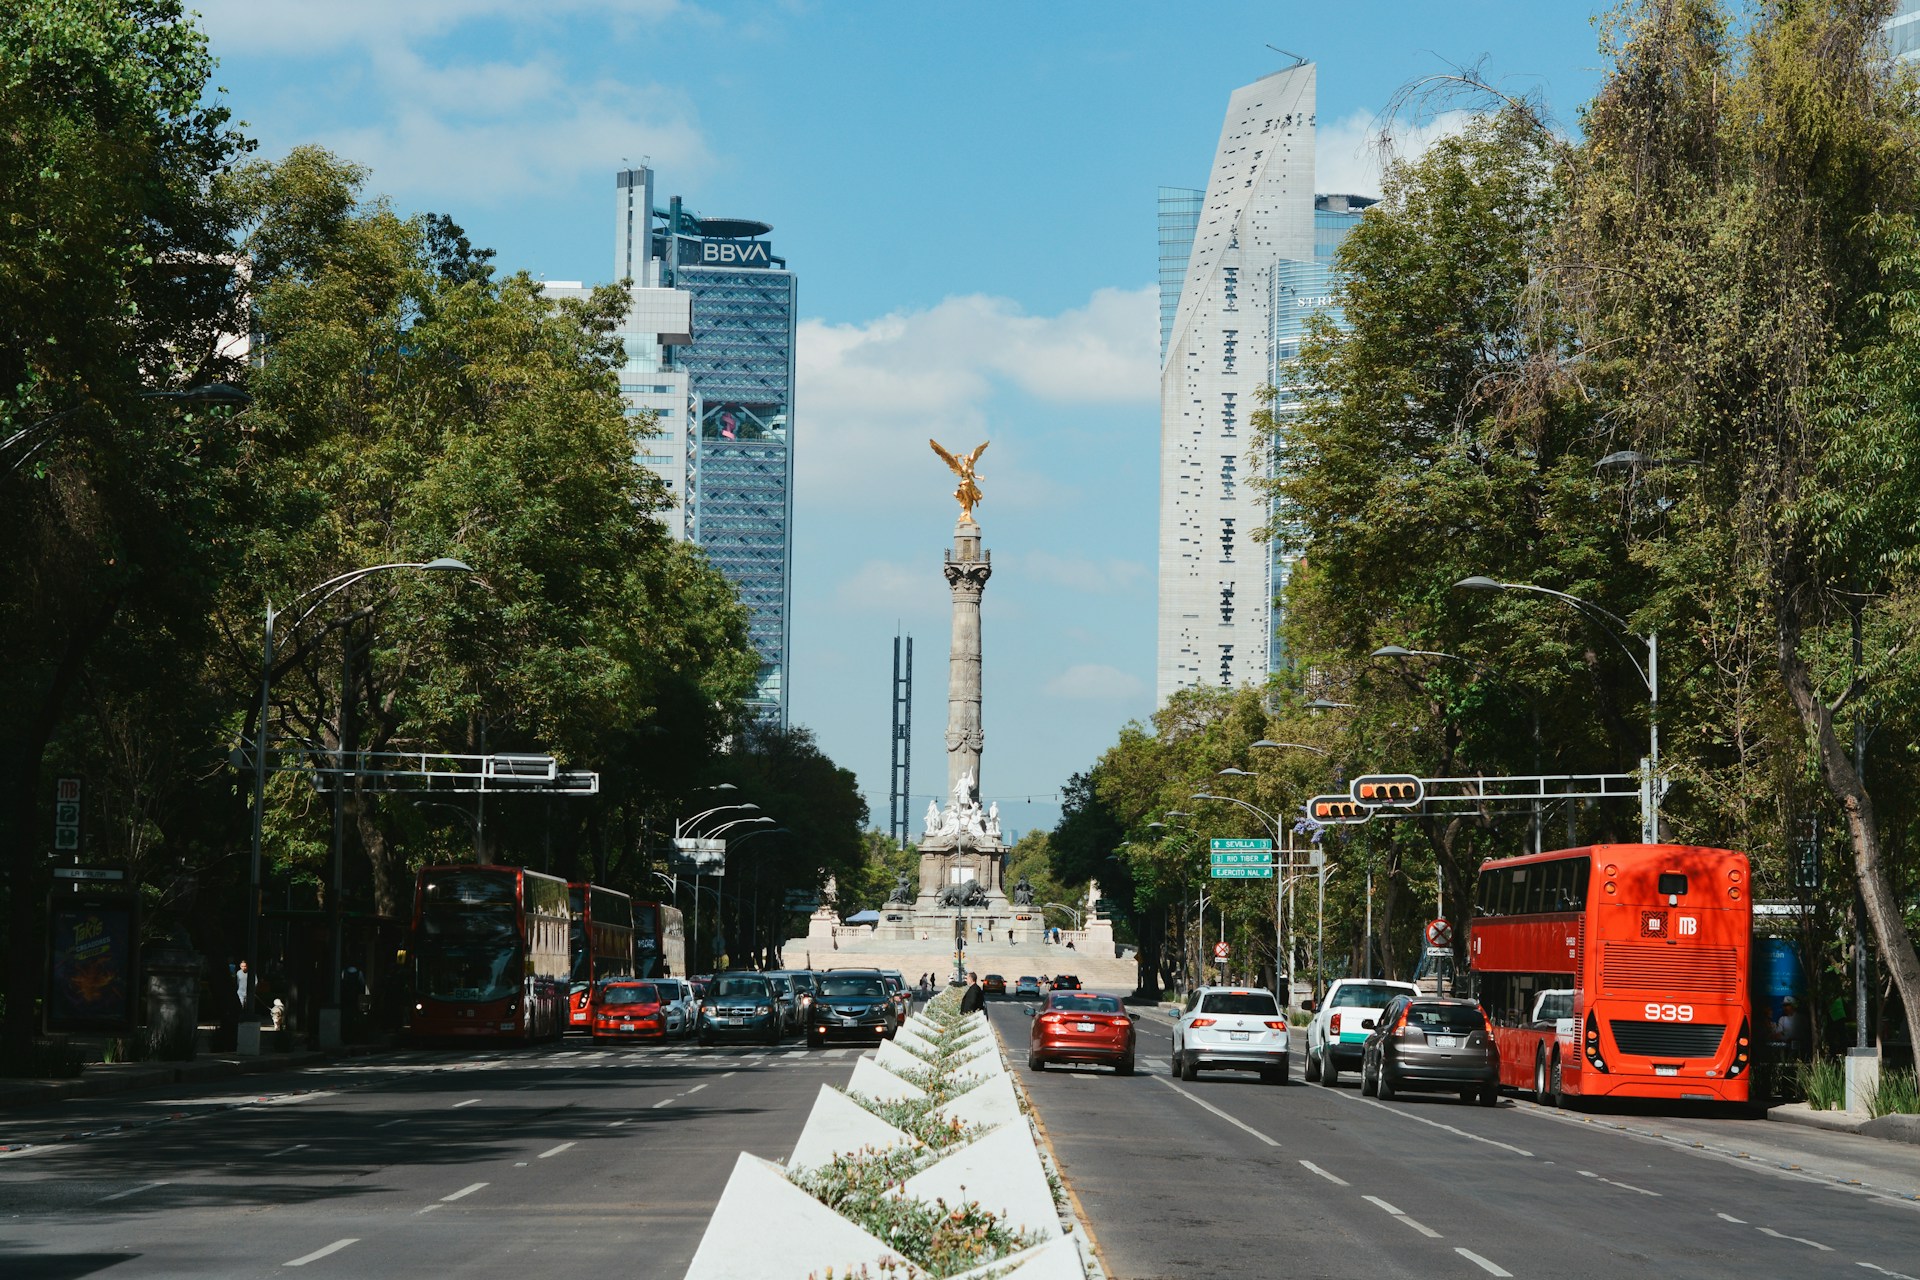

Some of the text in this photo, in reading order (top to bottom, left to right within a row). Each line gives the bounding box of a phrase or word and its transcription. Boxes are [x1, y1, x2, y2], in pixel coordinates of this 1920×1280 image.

[703, 243, 768, 262] BBVA
[1678, 916, 1697, 935] MB
[1644, 1003, 1695, 1022] 939
